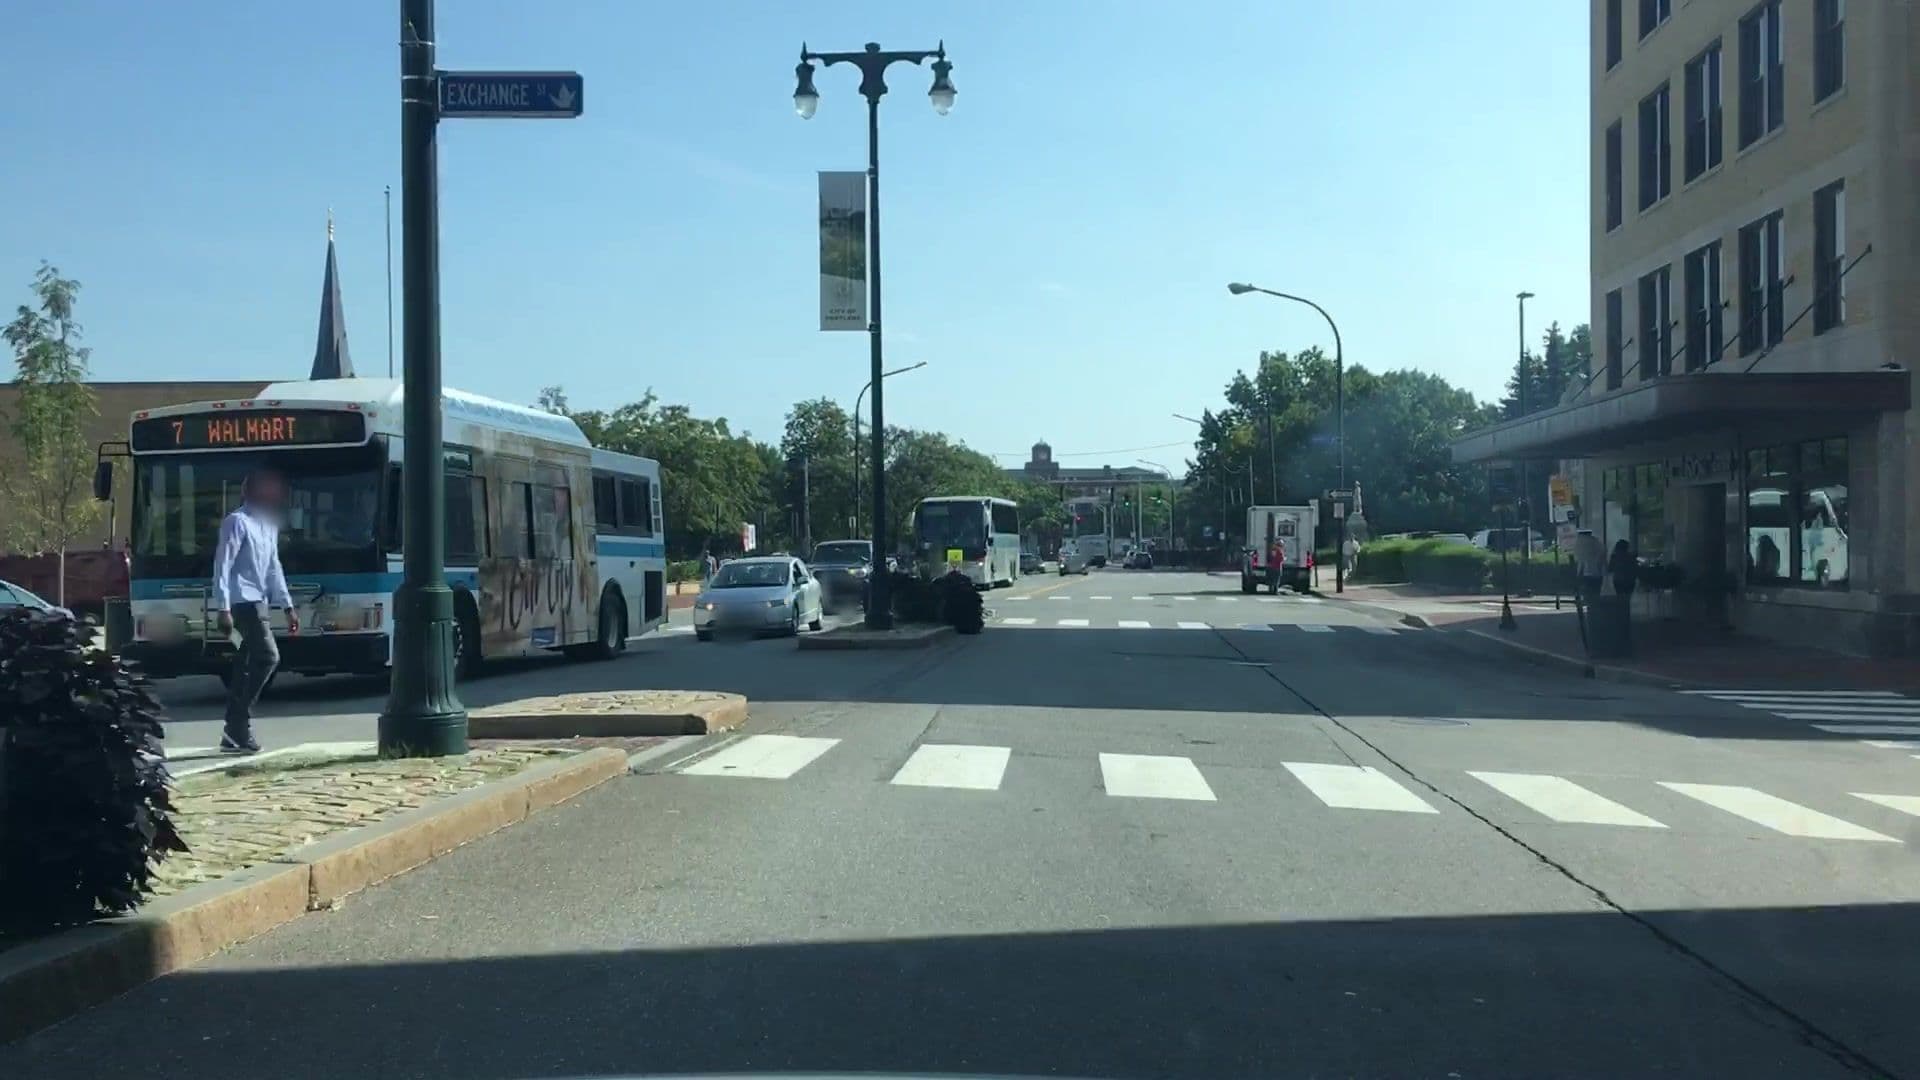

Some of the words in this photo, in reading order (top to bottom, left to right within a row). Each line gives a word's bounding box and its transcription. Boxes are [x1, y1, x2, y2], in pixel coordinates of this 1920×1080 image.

[446, 83, 530, 106] EXCHANGE
[171, 421, 184, 444] 7
[207, 417, 297, 443] WALMART
